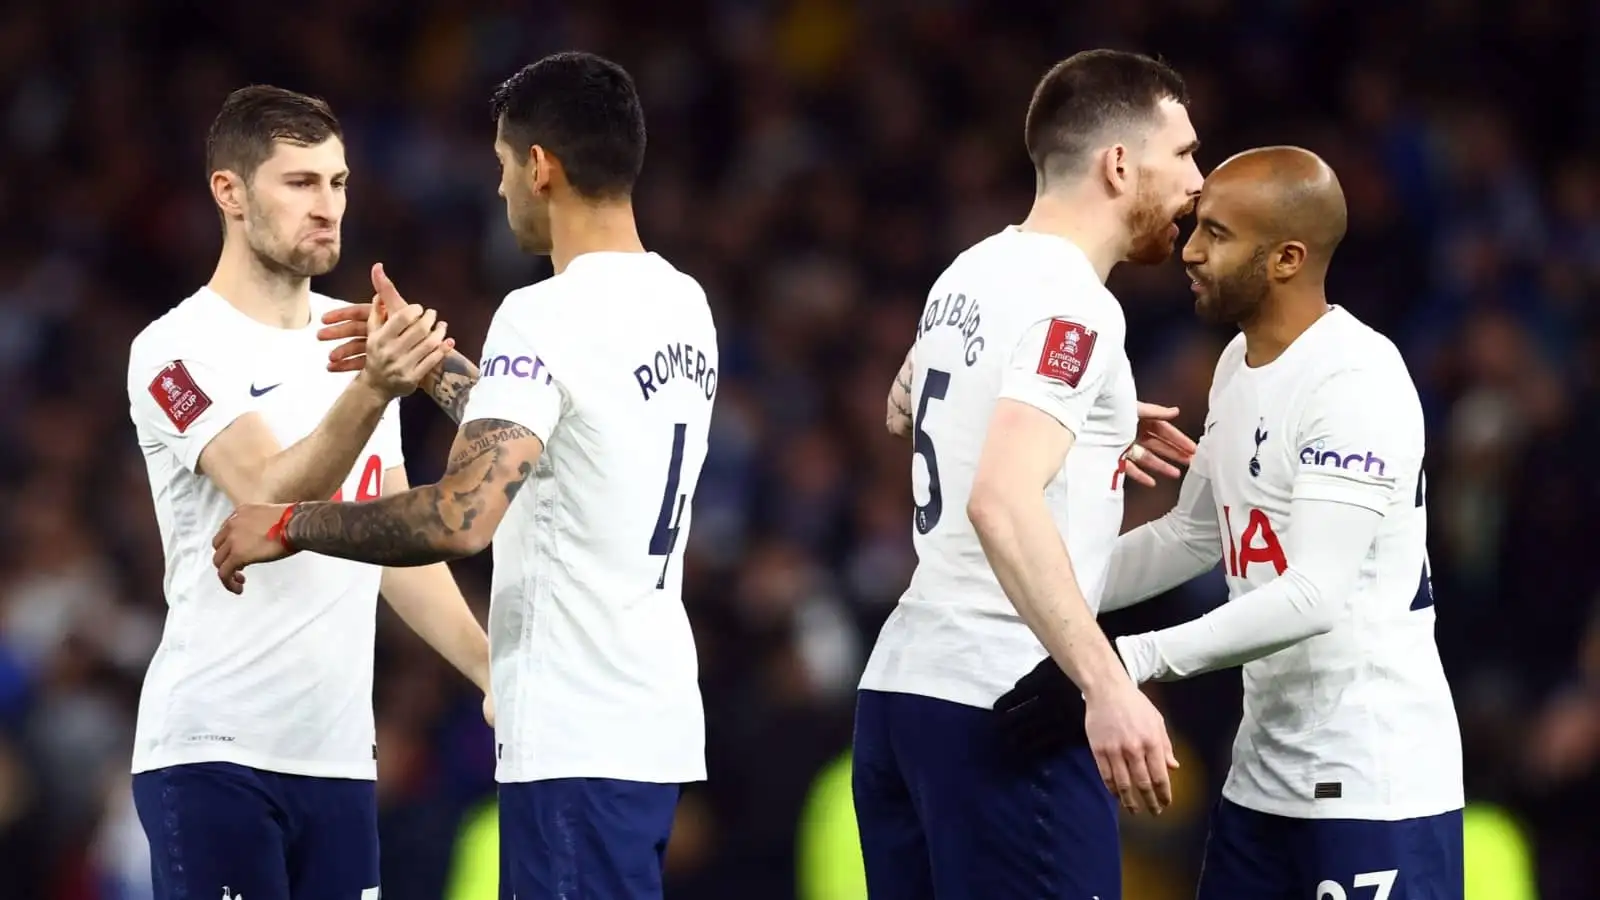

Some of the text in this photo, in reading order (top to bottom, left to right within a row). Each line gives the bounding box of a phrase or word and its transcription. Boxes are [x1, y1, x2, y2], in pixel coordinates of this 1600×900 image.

[481, 354, 553, 386] inch
[633, 342, 716, 401] ROMERO
[1047, 357, 1060, 368] FA
[1060, 361, 1080, 374] CUP
[1049, 350, 1081, 367] Emirates
[172, 409, 185, 421] FA
[181, 394, 197, 412] CUP
[914, 368, 951, 535] 5
[1299, 440, 1386, 476] cinch
[648, 423, 688, 590] 4
